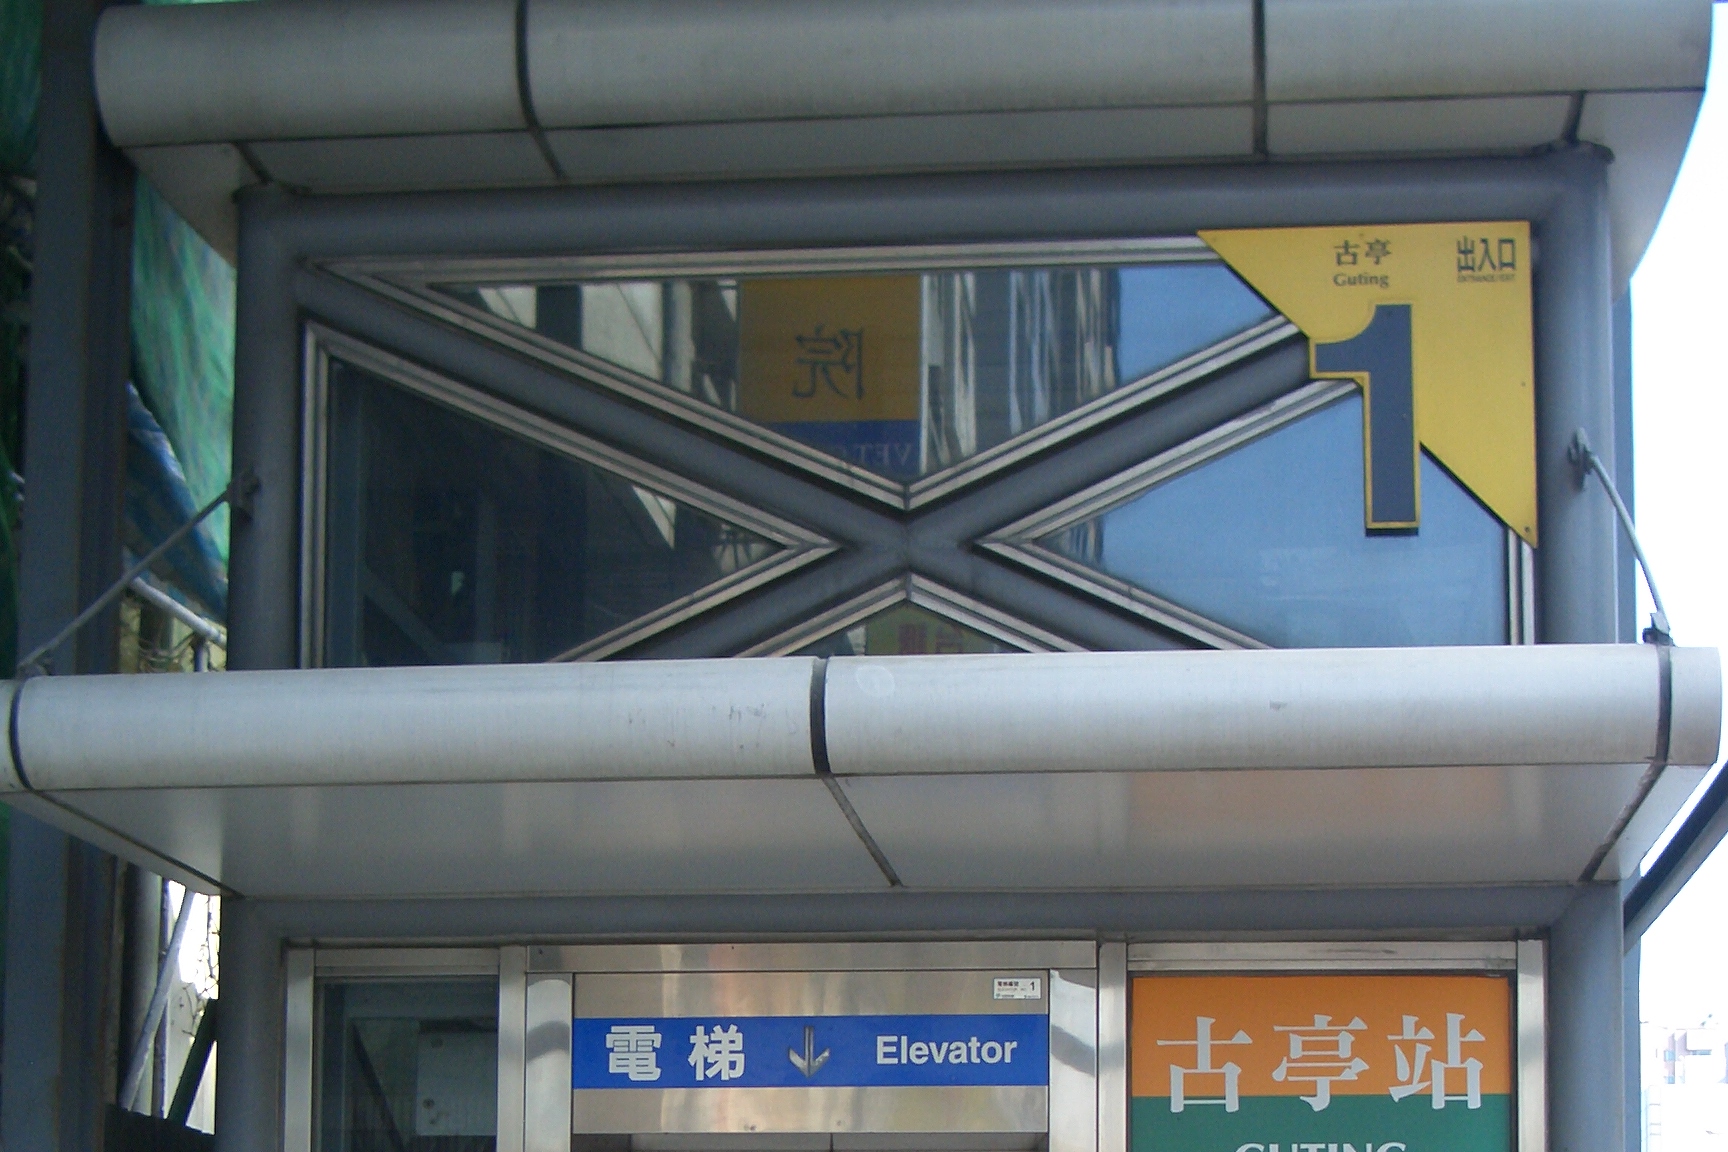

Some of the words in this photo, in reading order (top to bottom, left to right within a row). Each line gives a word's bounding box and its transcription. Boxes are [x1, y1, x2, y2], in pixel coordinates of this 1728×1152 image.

[1333, 238, 1392, 266] 古亭
[1456, 235, 1517, 273] 出入口
[1333, 273, 1390, 289] Guting
[1315, 304, 1416, 523] 1
[1030, 981, 1035, 991] 1
[605, 1024, 746, 1081] 電梯
[875, 1034, 1018, 1065] Elevator
[1156, 1012, 1487, 1114] 古亭站
